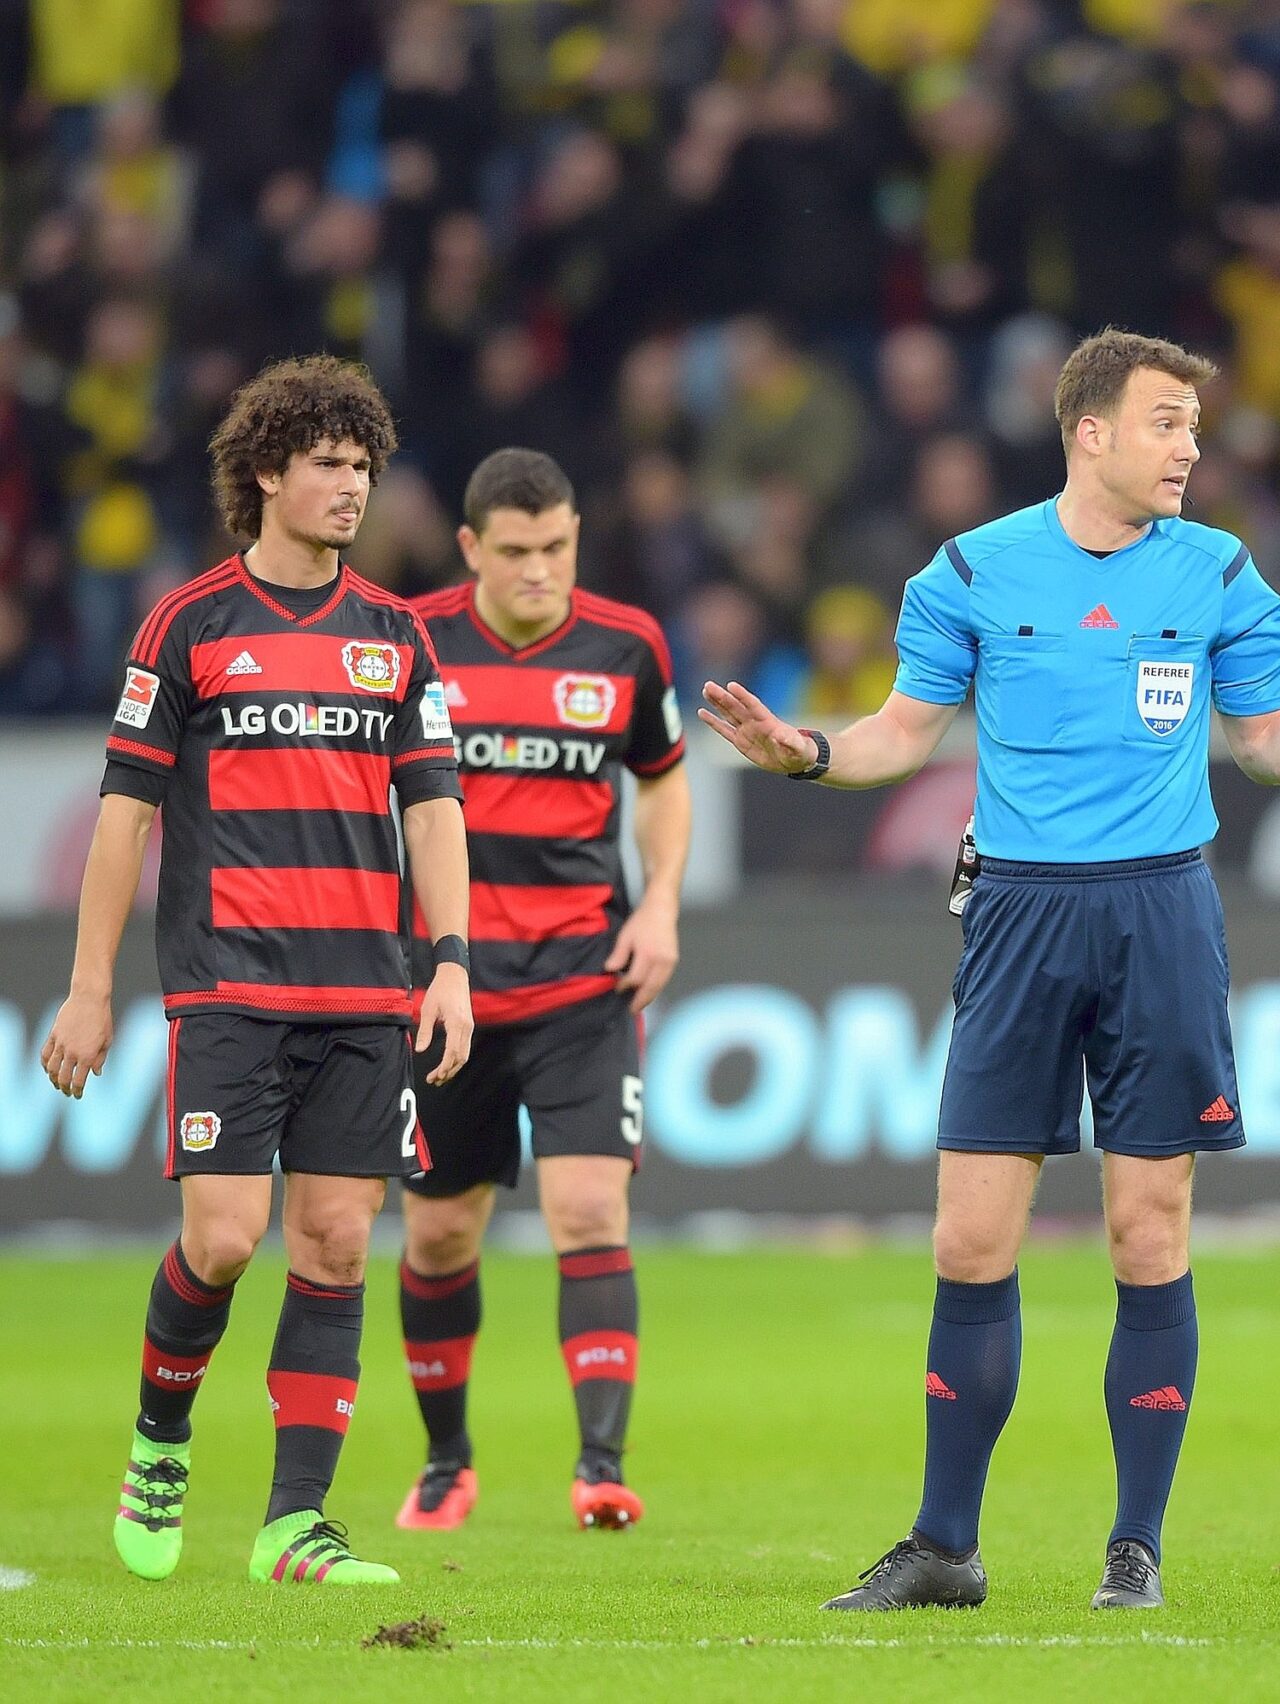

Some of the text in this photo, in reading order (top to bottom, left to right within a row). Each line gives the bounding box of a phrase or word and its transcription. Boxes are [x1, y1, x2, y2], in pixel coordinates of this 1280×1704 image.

[1079, 619, 1120, 630] adidas
[226, 665, 263, 676] adidas
[1143, 667, 1190, 678] REFEREE
[1144, 689, 1184, 705] FIFA
[221, 703, 394, 742] LG OLED TV
[426, 720, 451, 731] Herm
[1152, 721, 1173, 730] 2016
[464, 733, 560, 769] OLED
[560, 740, 606, 774] TV
[621, 1075, 644, 1145] 5
[1200, 1111, 1234, 1122] adidas
[400, 1087, 417, 1157] 2
[1130, 1394, 1187, 1412] adidas
